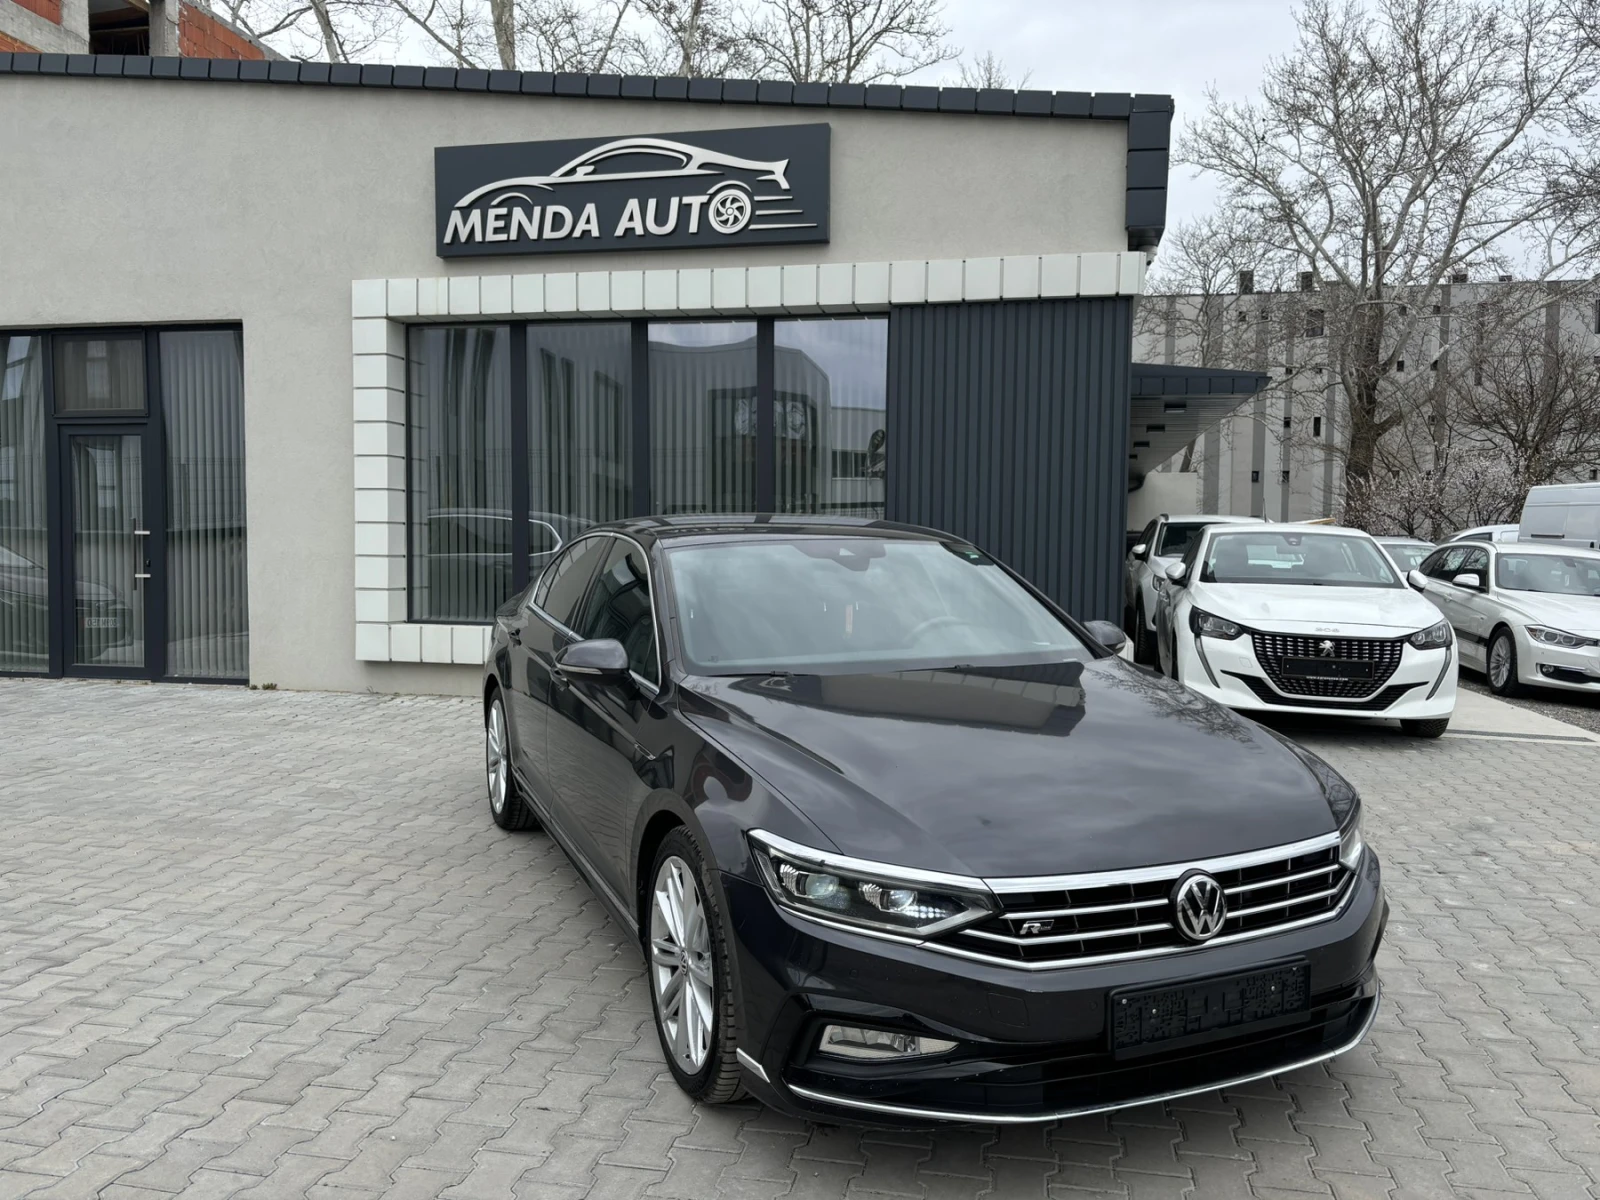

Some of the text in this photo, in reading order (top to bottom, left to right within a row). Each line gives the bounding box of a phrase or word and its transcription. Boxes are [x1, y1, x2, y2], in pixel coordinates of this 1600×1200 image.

[443, 189, 752, 244] MENDA AUTO
[1178, 875, 1227, 939] VW
